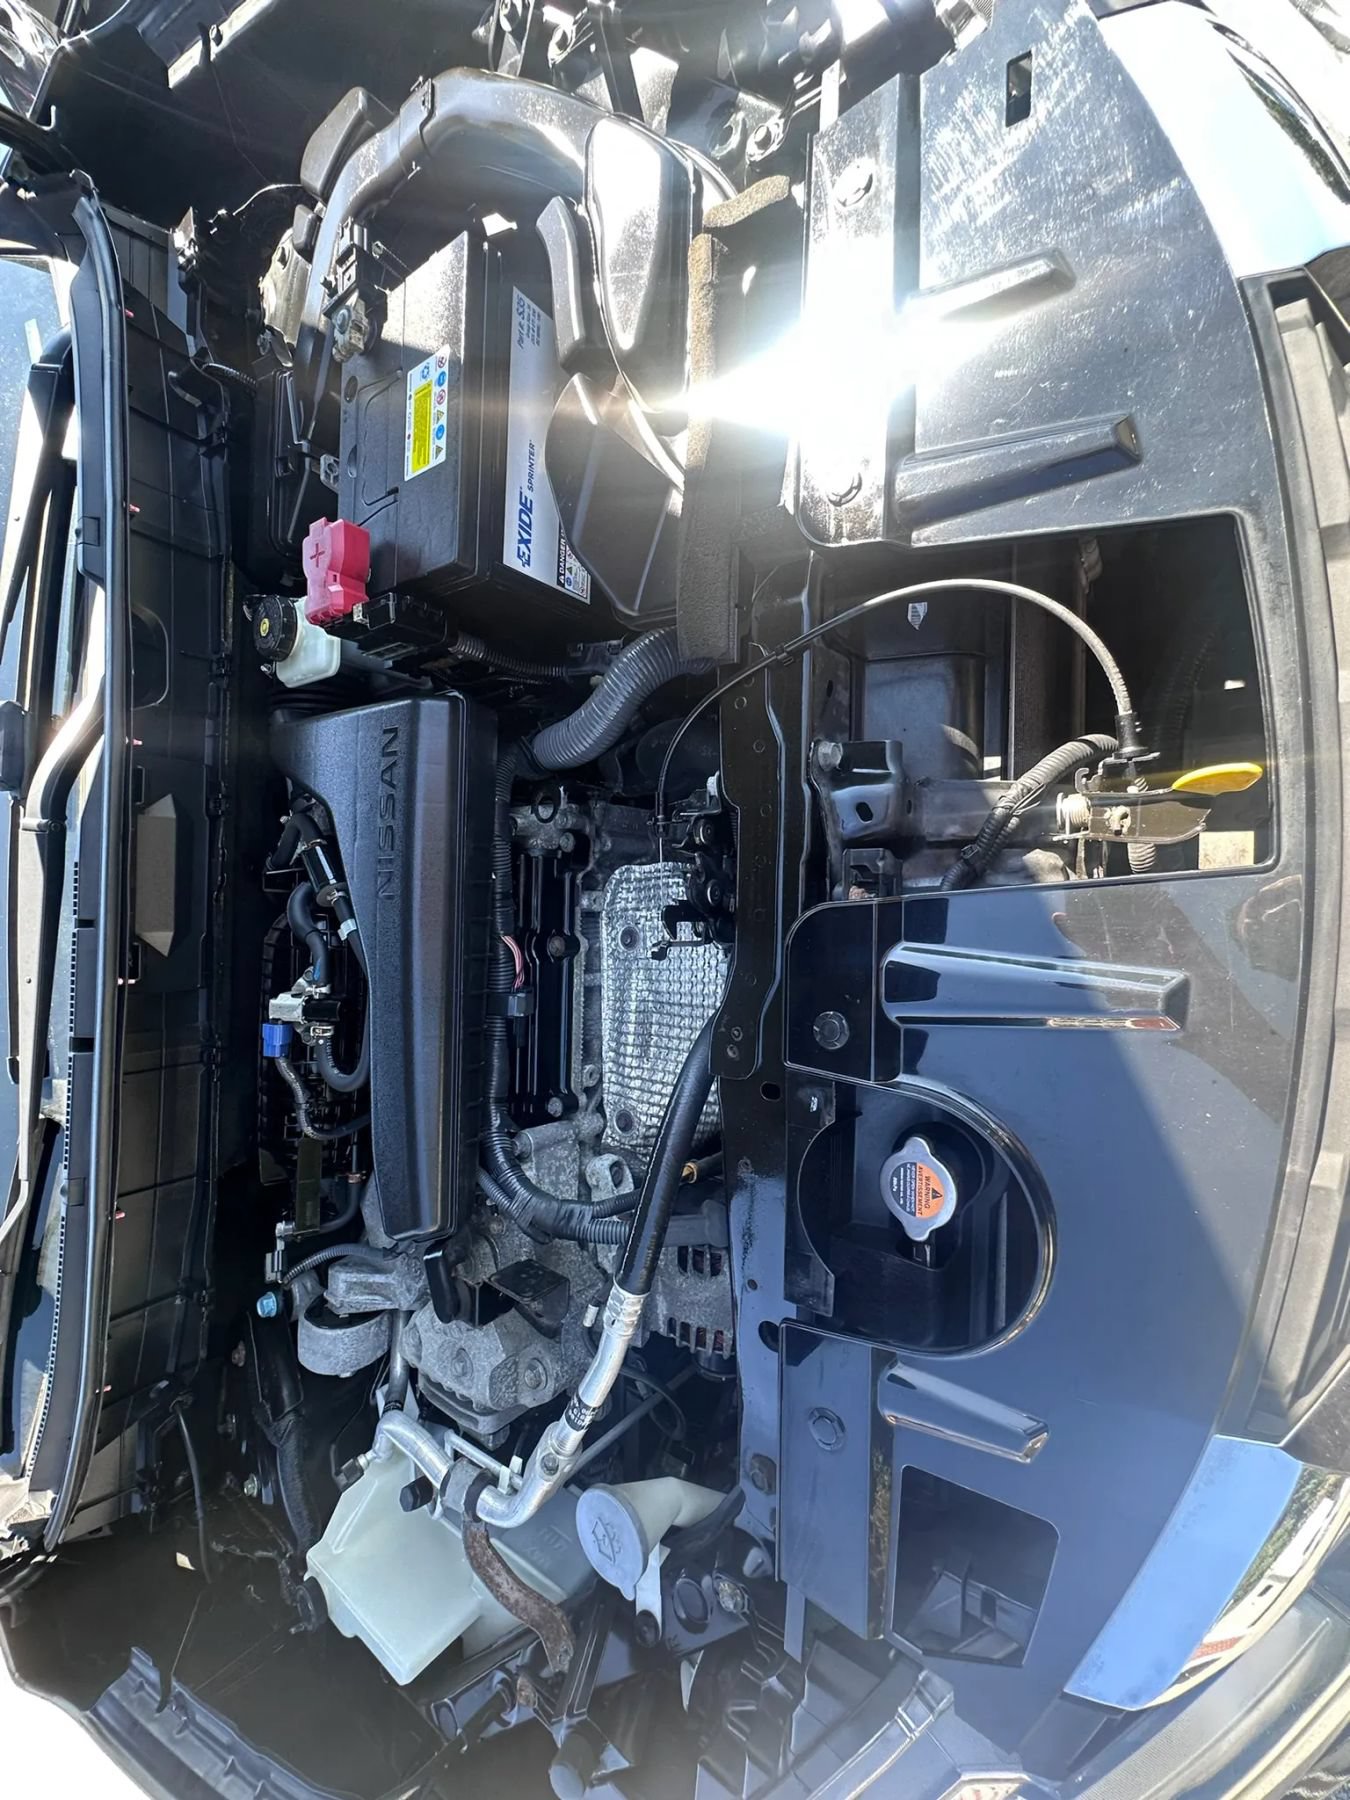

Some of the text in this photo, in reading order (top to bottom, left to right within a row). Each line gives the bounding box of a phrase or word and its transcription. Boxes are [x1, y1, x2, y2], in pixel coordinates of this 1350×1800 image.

[517, 442, 536, 568] EXIDE SPRINTER
[376, 724, 399, 901] NISSAN
